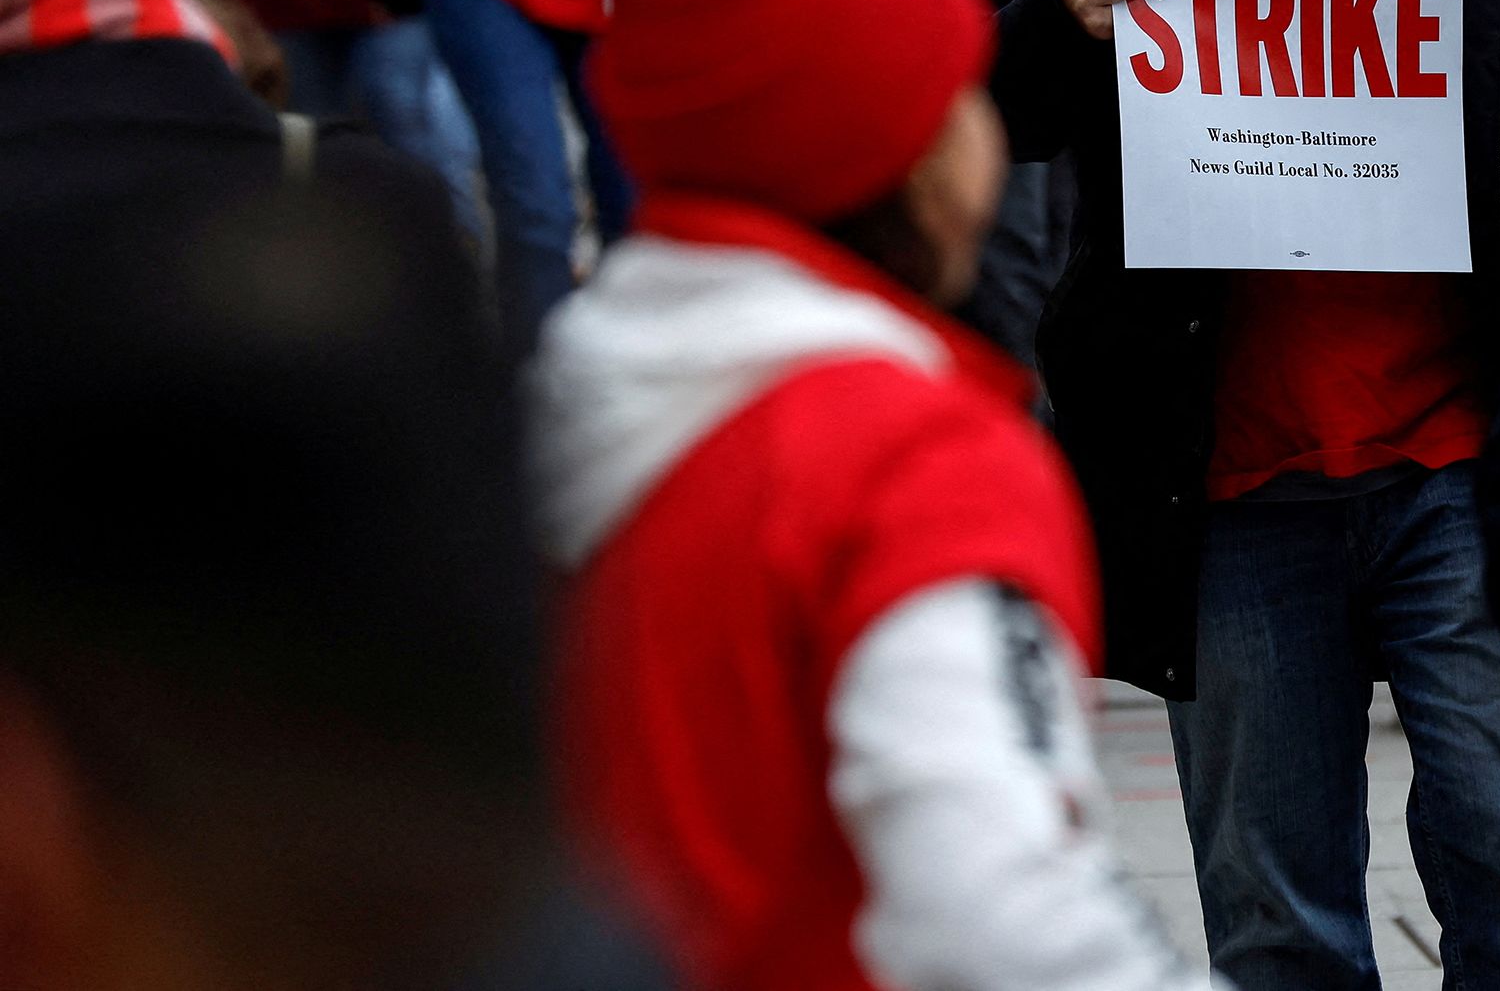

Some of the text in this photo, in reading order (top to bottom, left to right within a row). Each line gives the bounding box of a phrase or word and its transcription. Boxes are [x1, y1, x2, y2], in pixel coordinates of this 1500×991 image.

[1207, 127, 1377, 148] Washington-Baltimore
[1190, 159, 1399, 179] News Guild Local No. 32035
